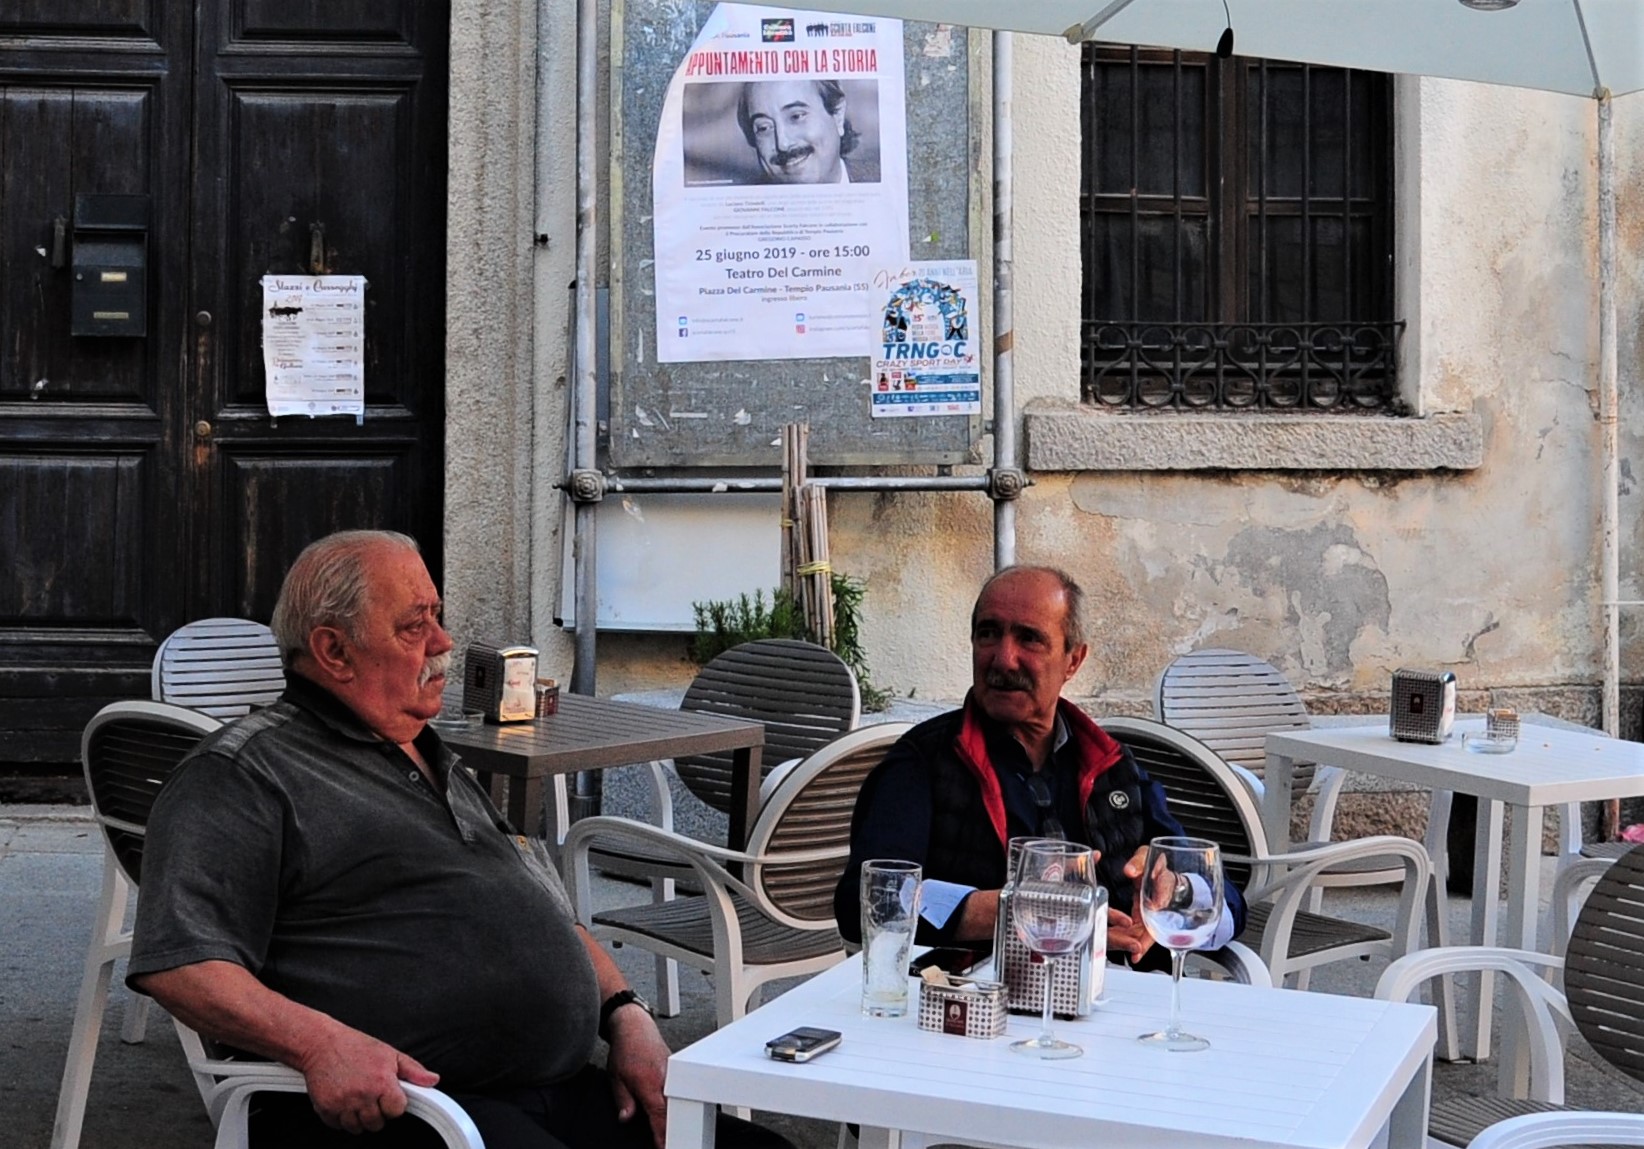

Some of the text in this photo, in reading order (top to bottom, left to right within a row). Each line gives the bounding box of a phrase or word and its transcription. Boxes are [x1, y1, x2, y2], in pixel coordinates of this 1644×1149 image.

[783, 49, 808, 73] CON
[815, 49, 829, 73] LA
[832, 48, 877, 72] STORIA
[695, 249, 712, 261] 25
[716, 248, 760, 263] giugno
[764, 246, 796, 260] 2019
[809, 247, 830, 258] ore
[835, 245, 871, 257] 15:00
[725, 265, 842, 280] Teatro Del Carmine
[699, 287, 725, 295] Piazza
[727, 286, 741, 294] Del
[743, 286, 777, 294] Carmine
[785, 285, 814, 294] Tempio
[816, 284, 851, 292] Pausania
[854, 283, 869, 292] (SS)
[876, 360, 908, 368] CRAZY
[909, 359, 942, 367] SPORT
